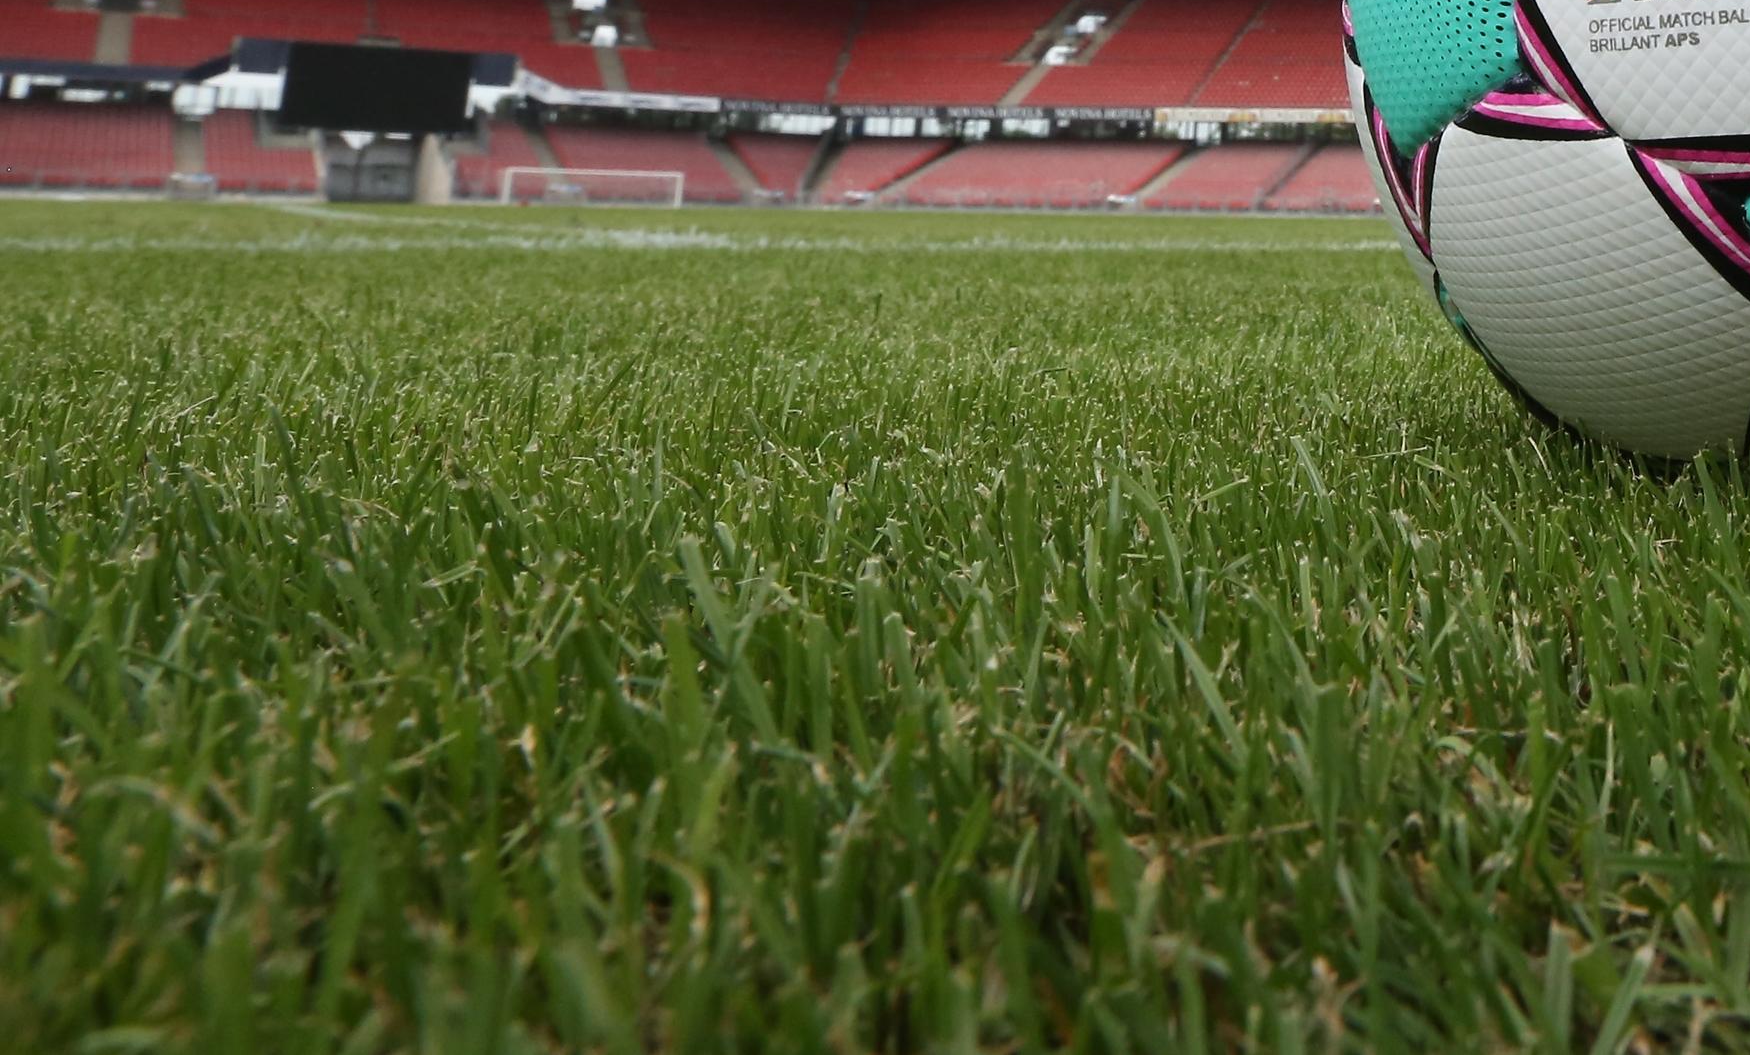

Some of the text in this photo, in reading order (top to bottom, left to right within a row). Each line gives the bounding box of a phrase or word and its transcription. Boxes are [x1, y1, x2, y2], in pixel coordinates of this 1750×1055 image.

[1589, 15, 1656, 33] OFFICIAL
[1659, 11, 1715, 29] MATCH
[1590, 32, 1701, 52] BRILLANT APS
